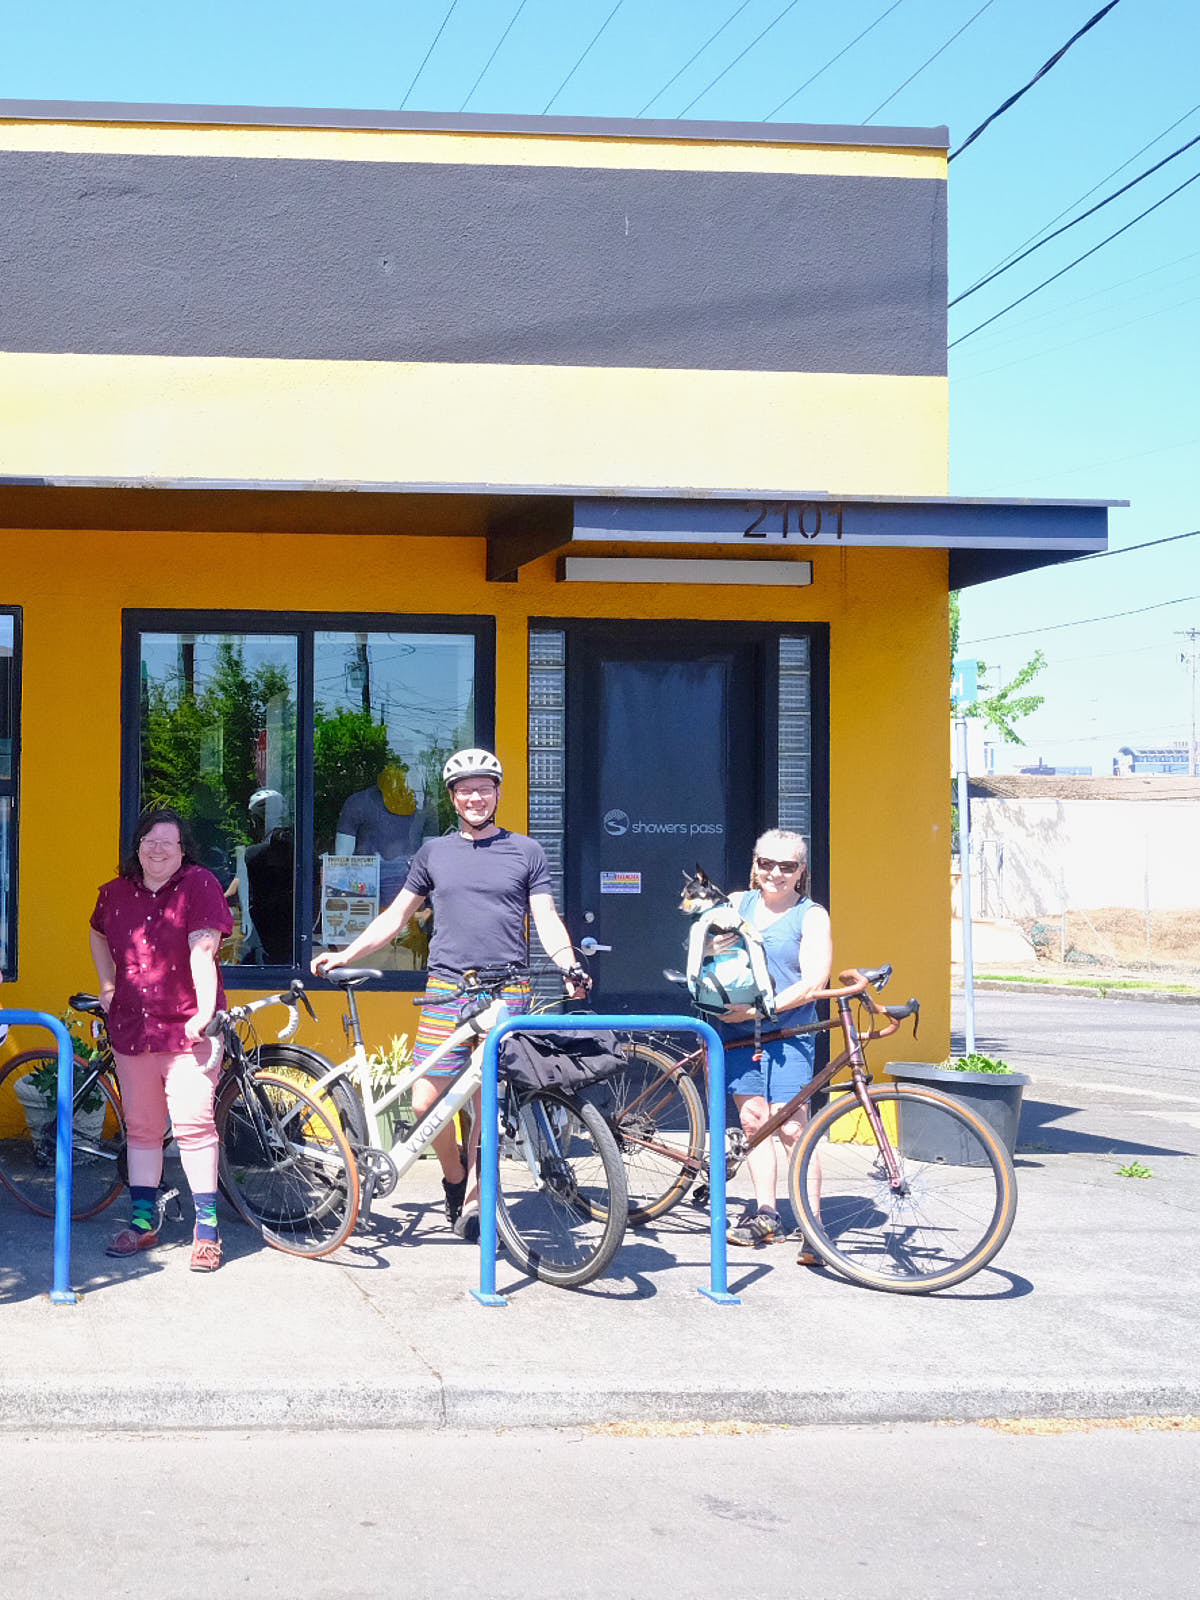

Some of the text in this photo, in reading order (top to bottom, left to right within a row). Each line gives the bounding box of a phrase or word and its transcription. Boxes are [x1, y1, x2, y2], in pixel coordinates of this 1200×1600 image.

[743, 501, 843, 540] 2101
[631, 819, 724, 839] showers pass
